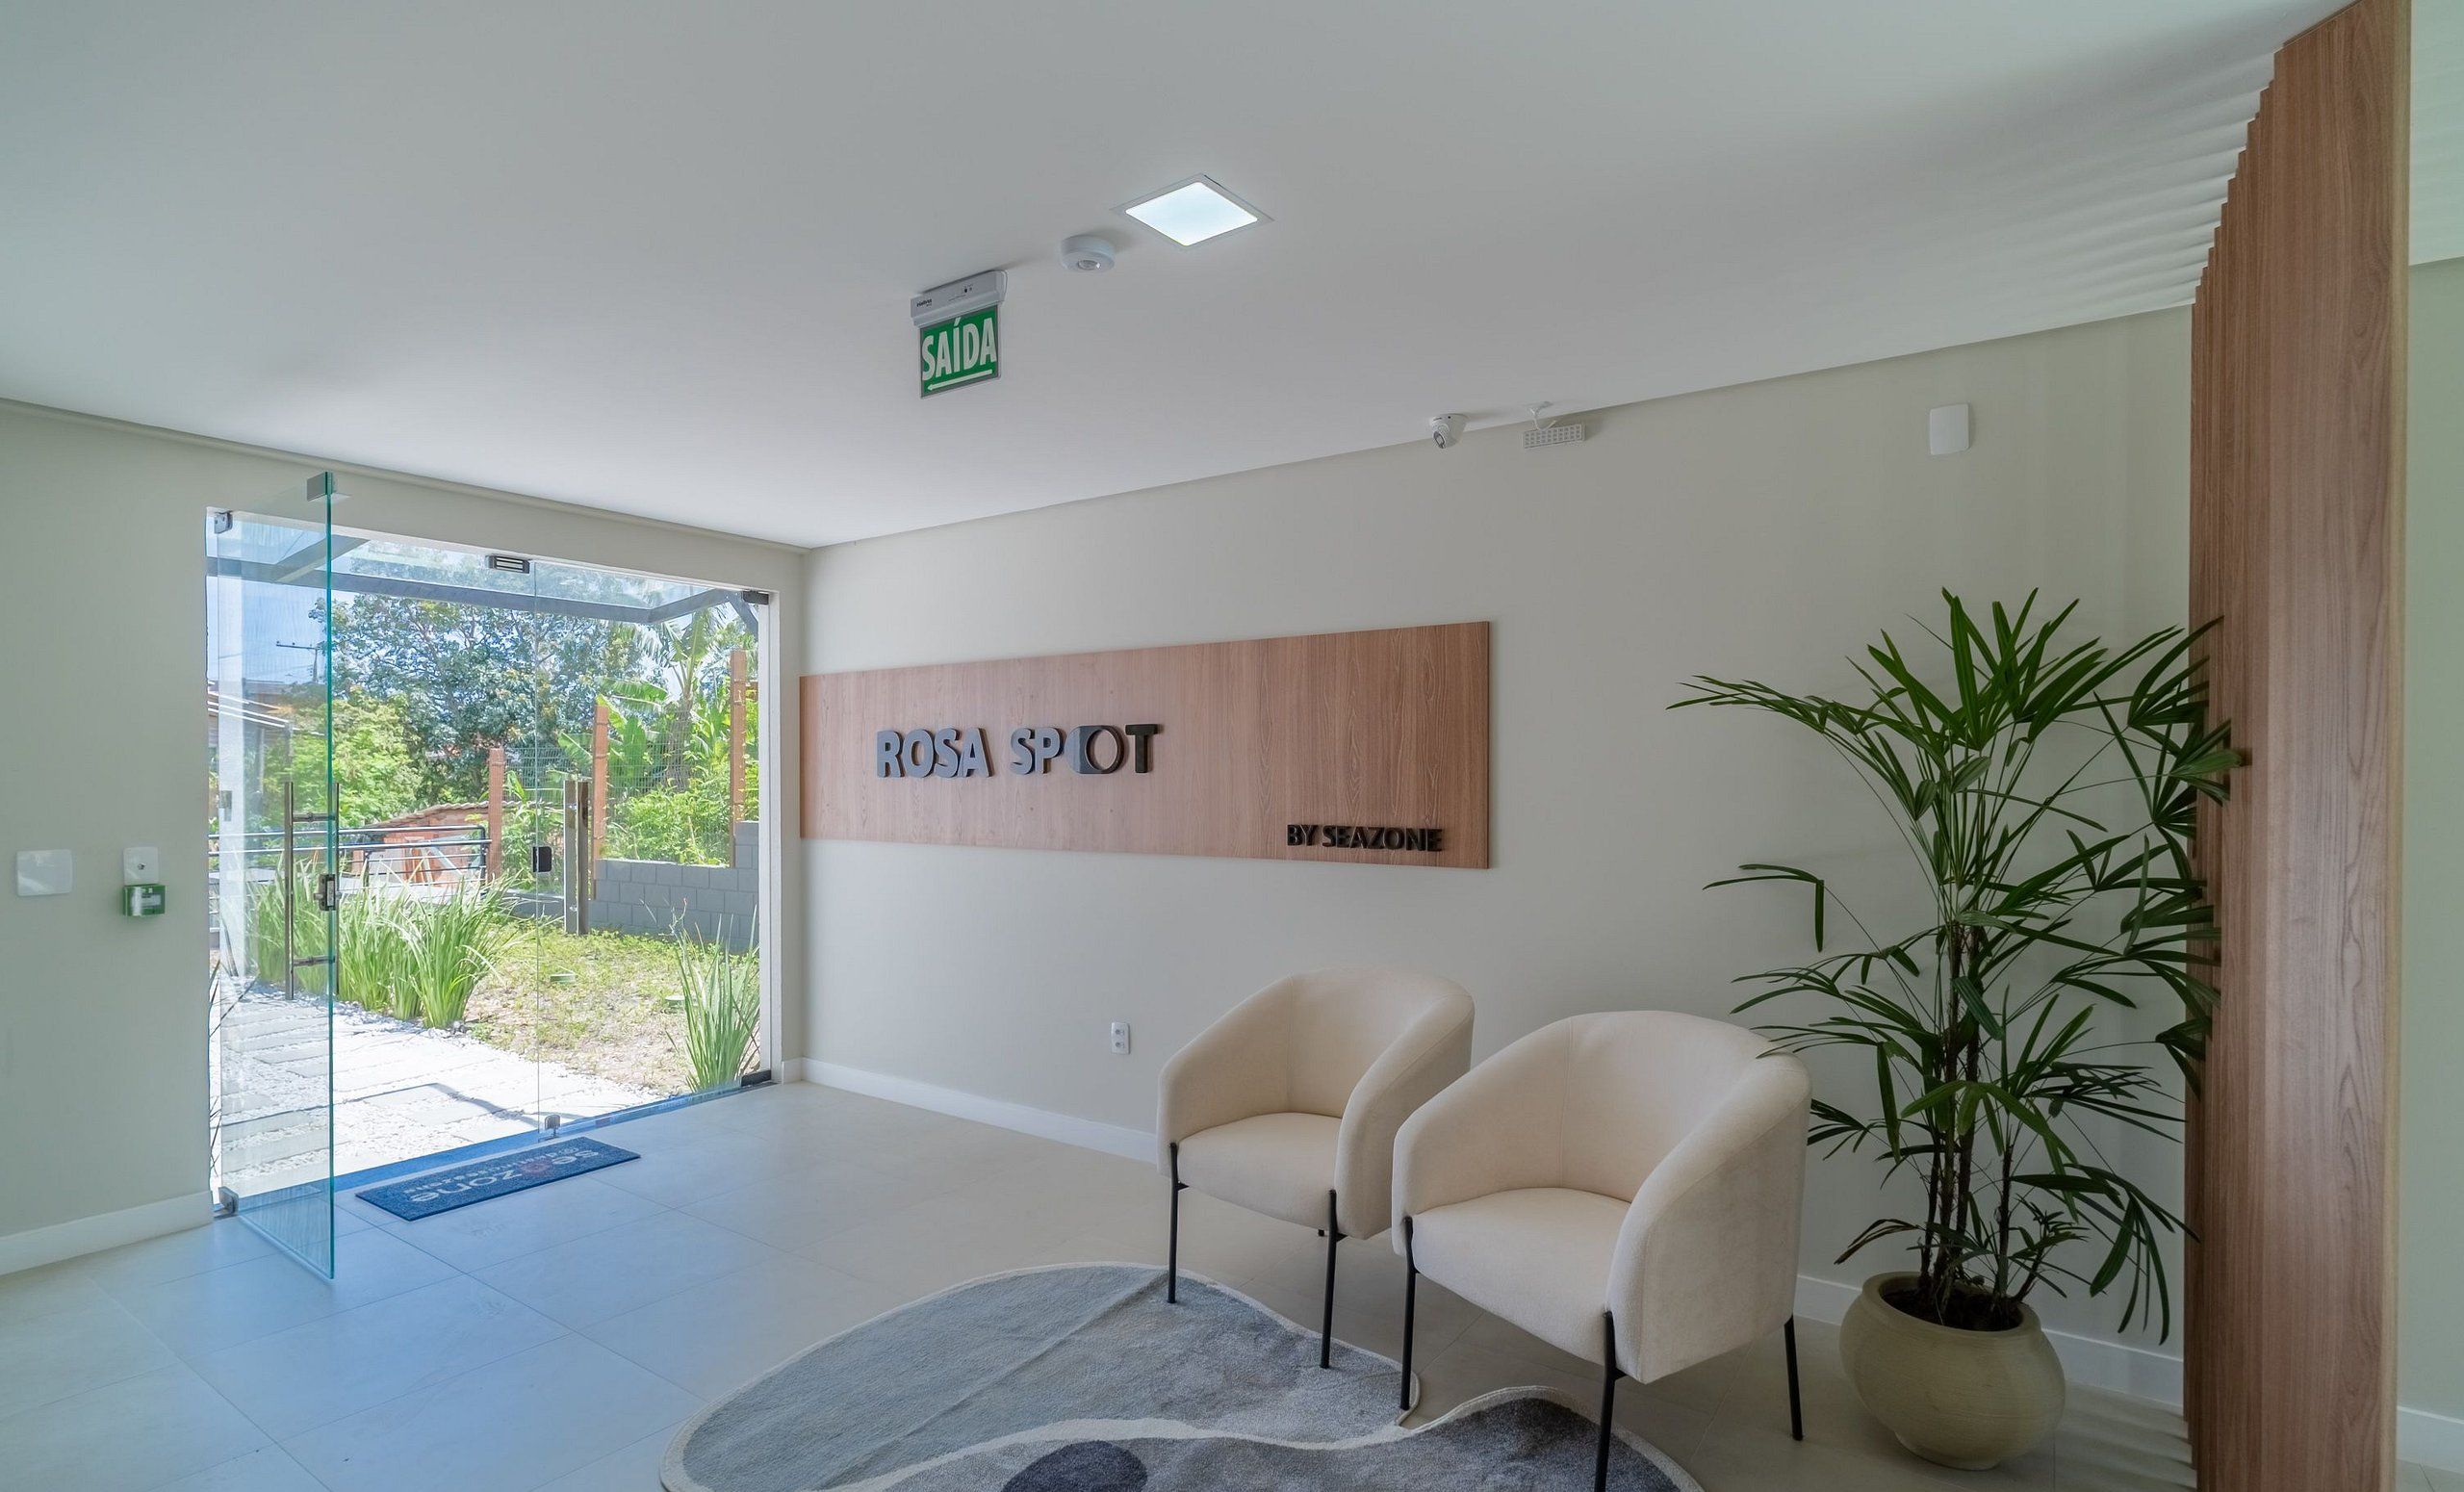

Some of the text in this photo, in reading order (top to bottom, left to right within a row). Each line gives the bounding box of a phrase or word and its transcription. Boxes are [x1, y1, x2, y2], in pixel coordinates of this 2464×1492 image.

[922, 318, 997, 381] SAÍDA
[877, 724, 1162, 778] ROSA SPOT
[1287, 824, 1443, 852] BY SEAZONE
